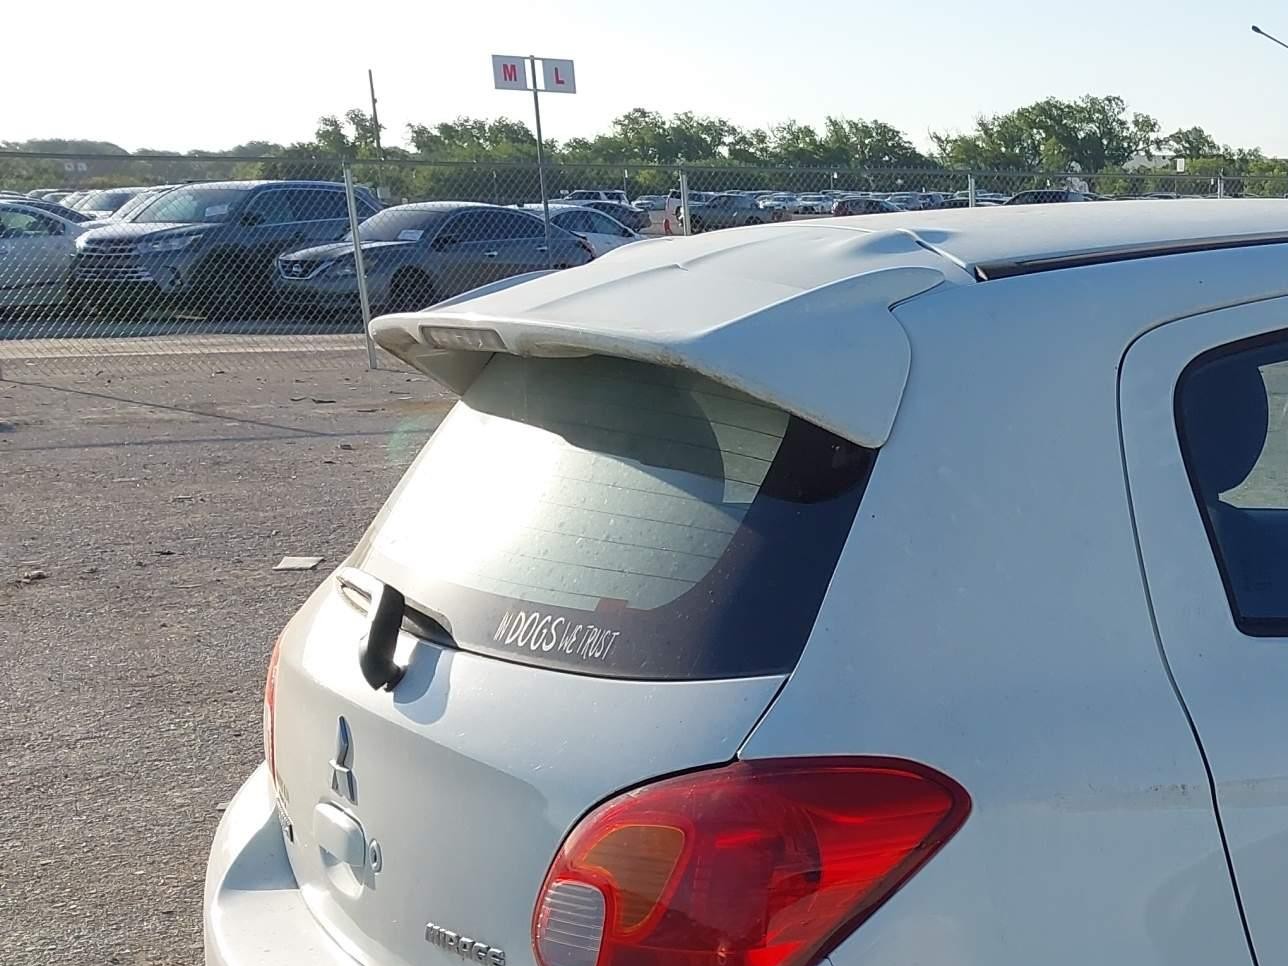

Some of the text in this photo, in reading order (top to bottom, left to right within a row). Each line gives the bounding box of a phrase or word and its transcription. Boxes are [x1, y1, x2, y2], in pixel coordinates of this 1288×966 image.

[502, 64, 518, 82] M
[554, 67, 565, 85] L
[493, 610, 513, 642] IN
[505, 610, 565, 652] DOGS
[577, 625, 621, 661] TRUST
